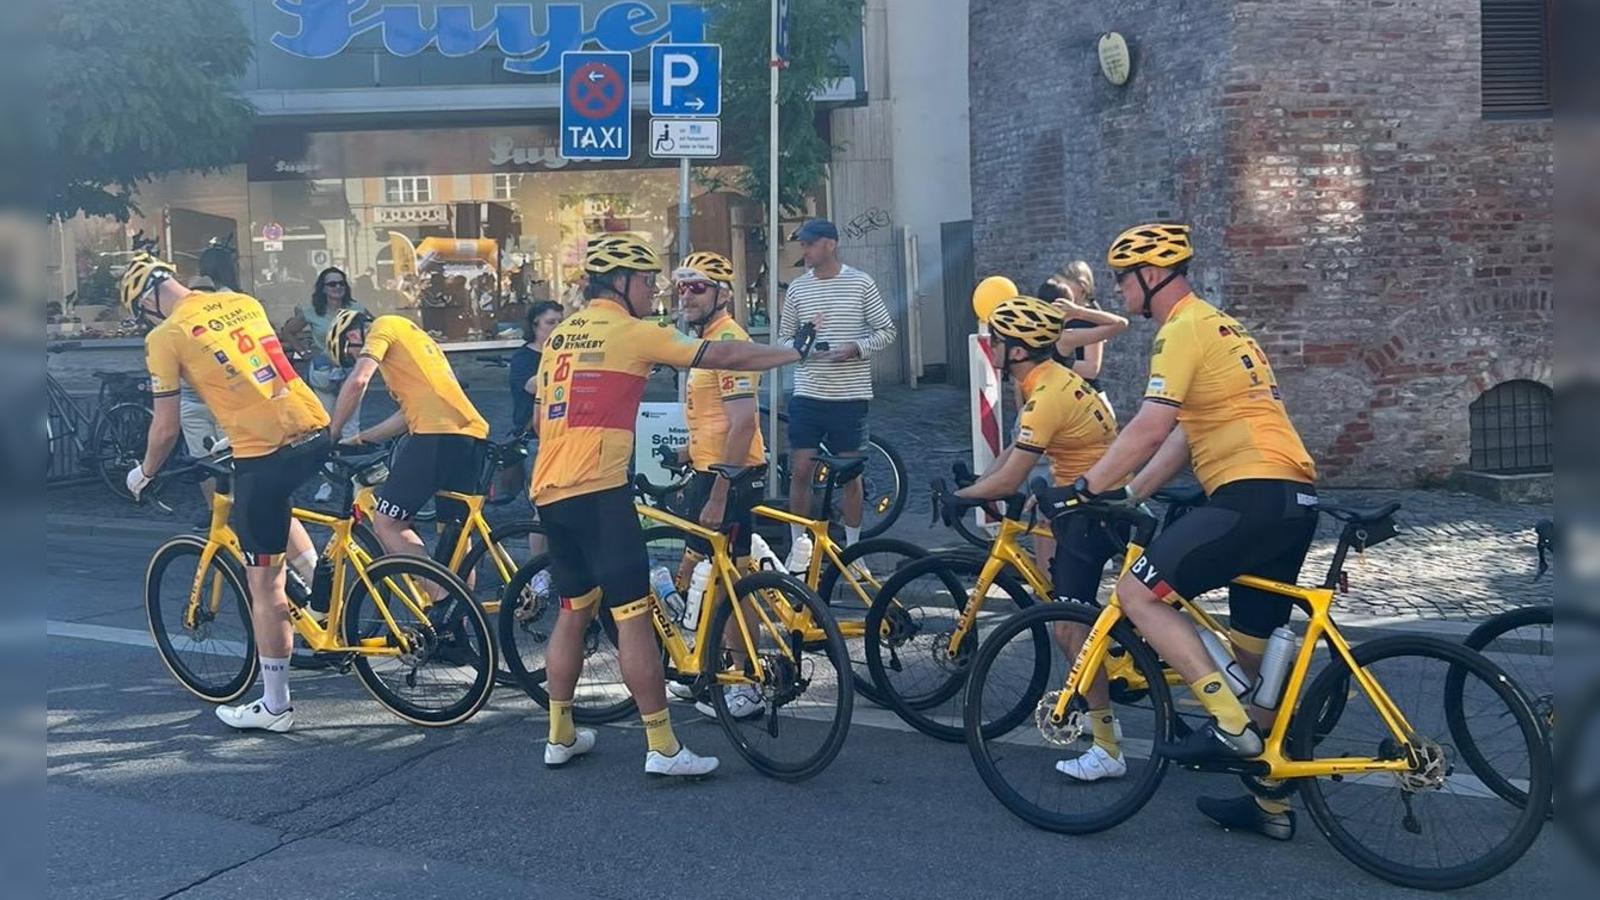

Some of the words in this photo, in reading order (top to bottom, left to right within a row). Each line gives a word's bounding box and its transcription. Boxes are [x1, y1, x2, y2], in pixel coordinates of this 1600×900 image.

[662, 53, 700, 107] P
[568, 126, 622, 149] TAXI
[218, 308, 242, 322] TEAM
[564, 339, 606, 350] RYNKEBY
[566, 333, 589, 342] TEAM
